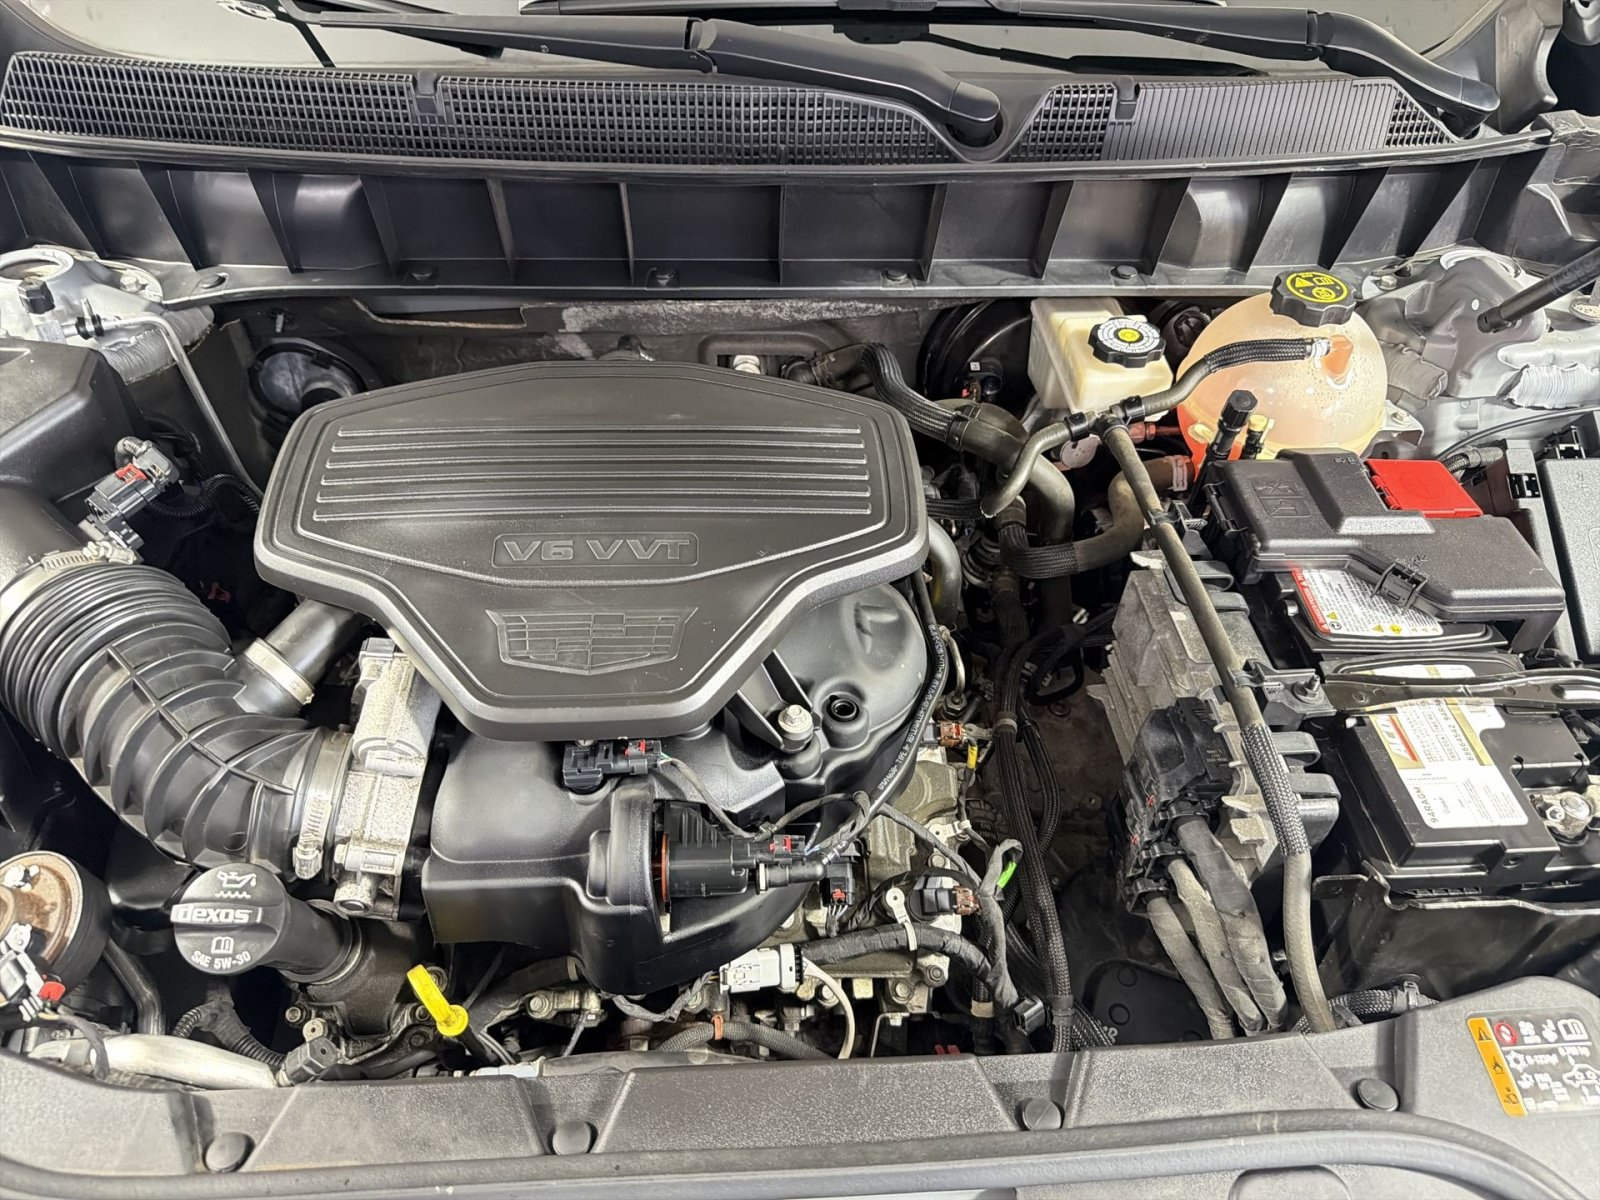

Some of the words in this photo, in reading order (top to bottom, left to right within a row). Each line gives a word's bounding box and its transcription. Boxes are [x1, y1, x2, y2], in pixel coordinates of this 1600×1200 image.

[503, 540, 574, 561] V6
[586, 539, 690, 560] VVT
[1413, 786, 1438, 823] 94RAGM
[179, 904, 254, 924] dexos
[191, 950, 212, 968] SAE
[213, 951, 251, 969] 5W-30
